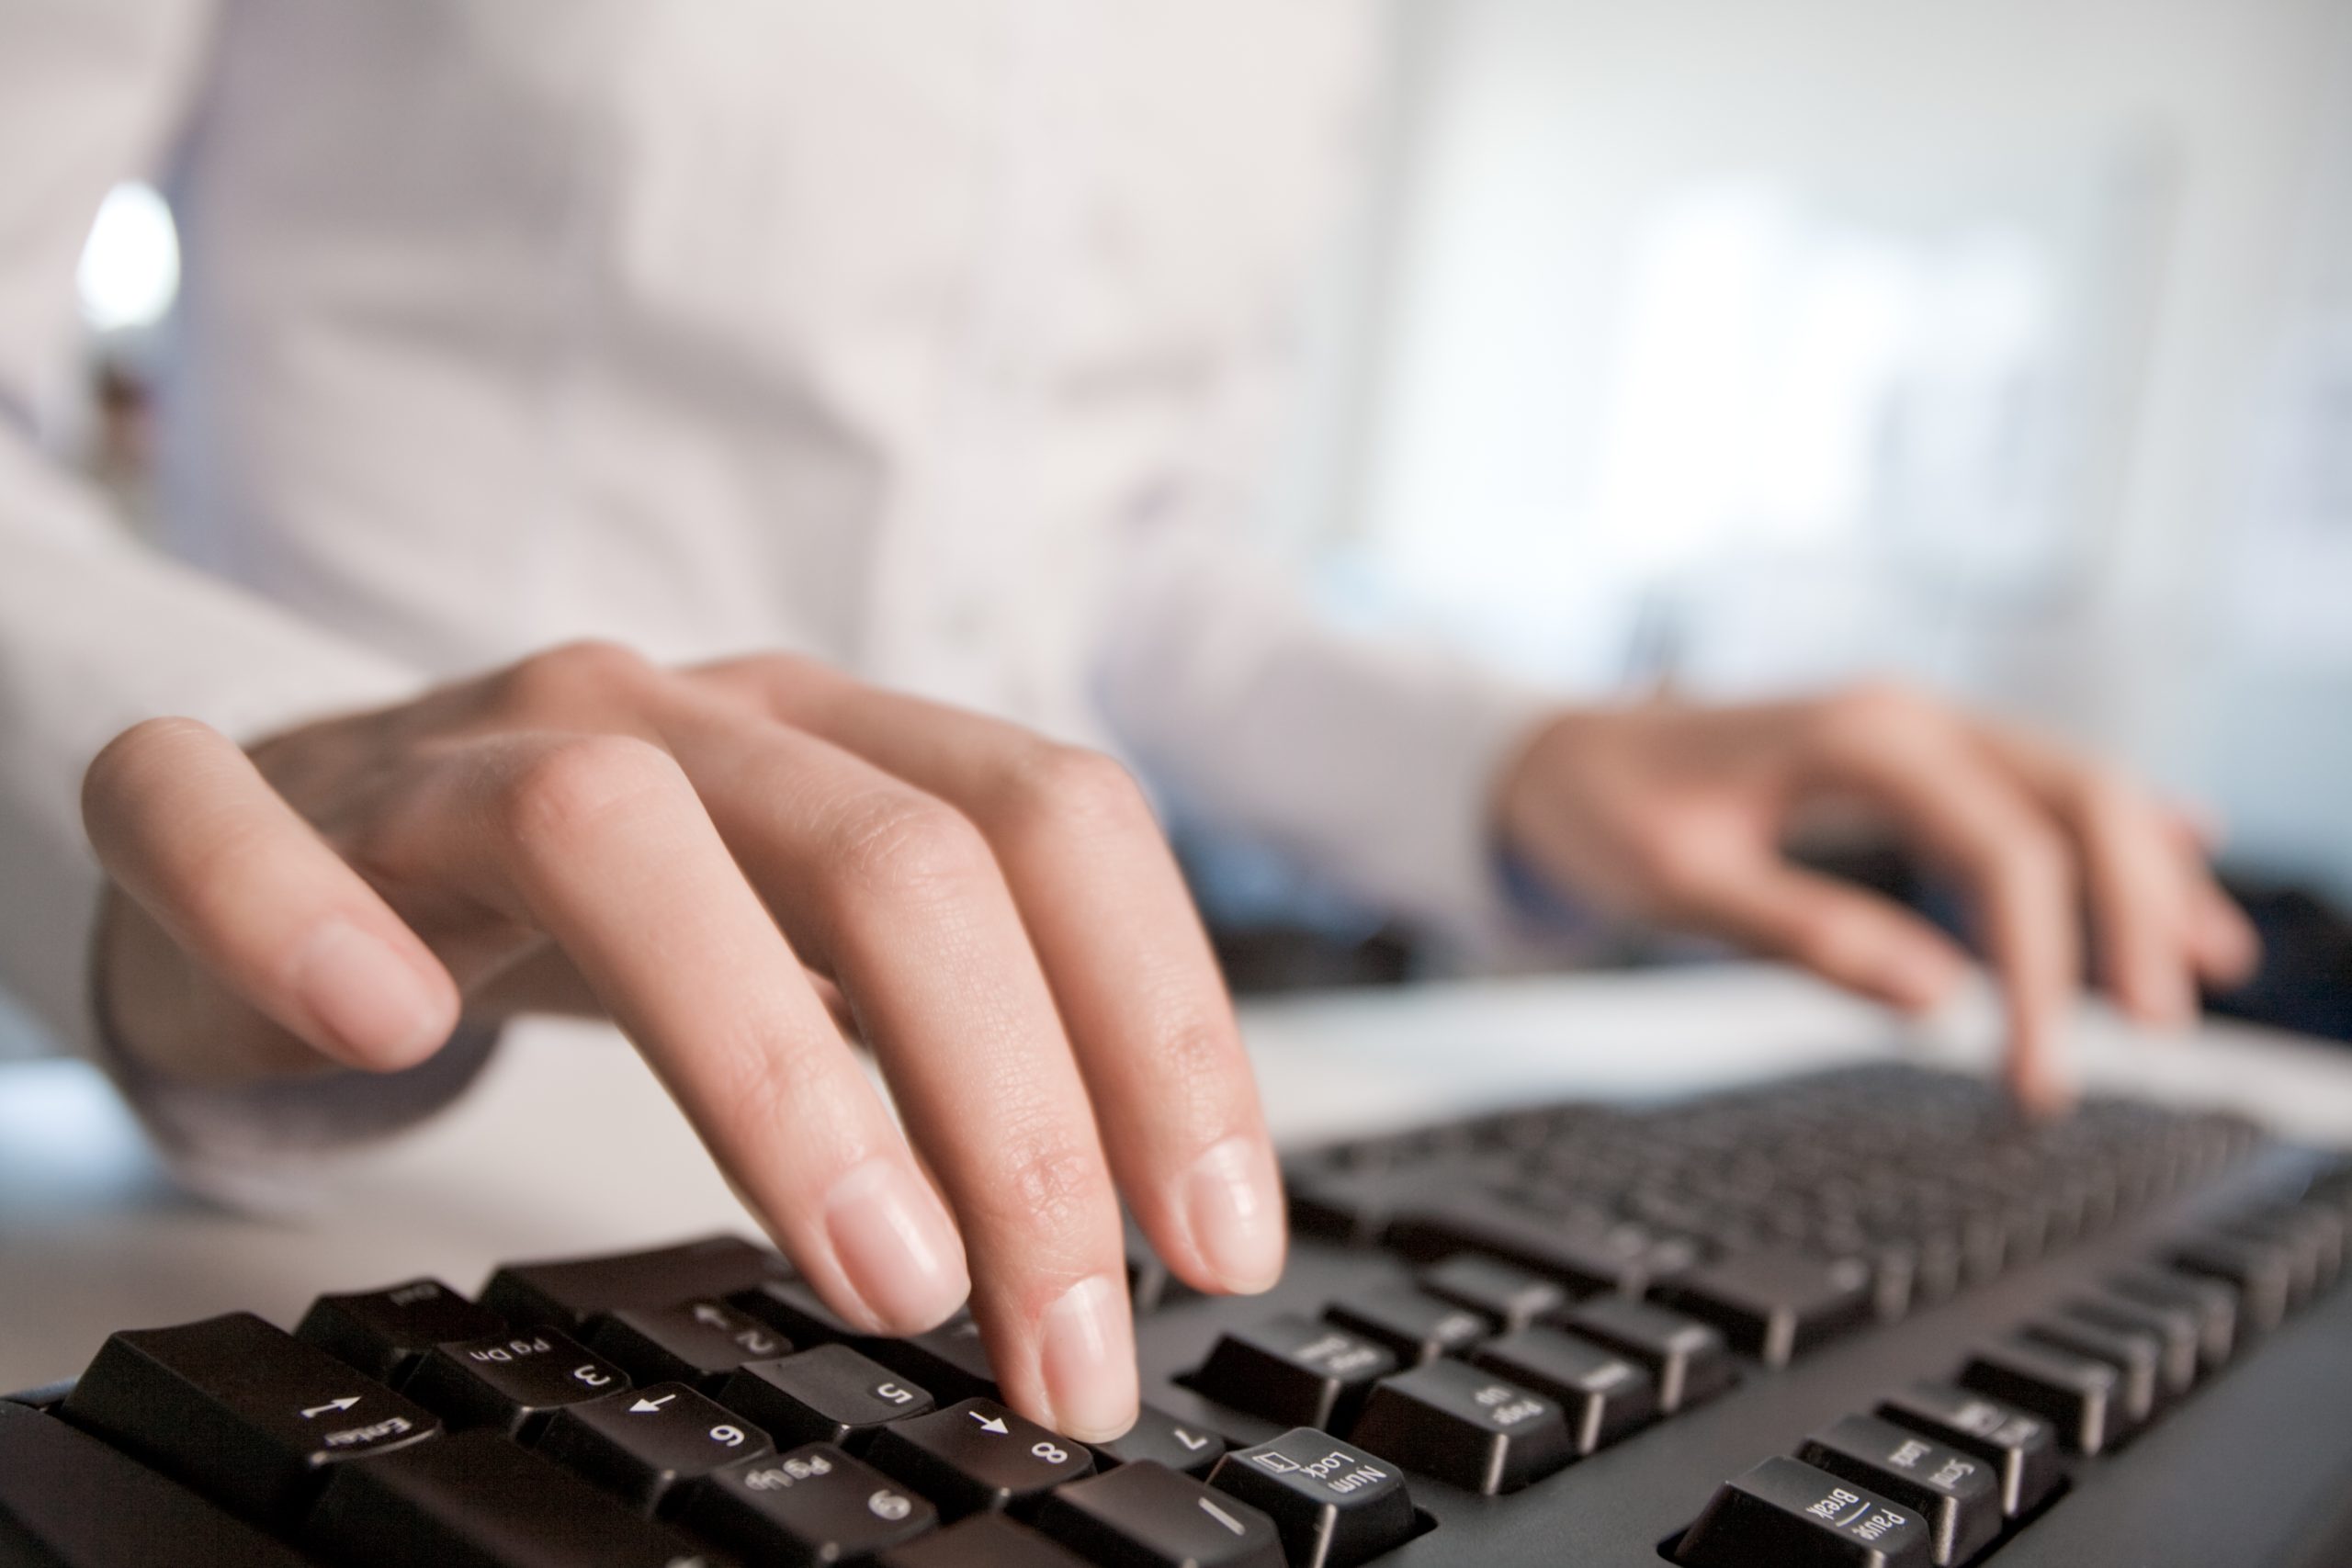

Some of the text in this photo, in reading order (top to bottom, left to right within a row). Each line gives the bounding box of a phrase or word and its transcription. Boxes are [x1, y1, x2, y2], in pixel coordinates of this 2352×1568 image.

[469, 1337, 550, 1363] Pg Dn
[738, 1331, 773, 1353] 2
[573, 1366, 611, 1386] 3
[877, 1382, 913, 1404] 5
[325, 1417, 412, 1447] Enter
[709, 1425, 745, 1447] 6
[1173, 1428, 1207, 1450] 7
[1031, 1441, 1068, 1463] 8
[1300, 1450, 1355, 1478] Lock
[1329, 1464, 1386, 1494] Num
[868, 1490, 911, 1519] 9
[1806, 1488, 1859, 1520] Break
[1851, 1508, 1905, 1540] Pause
